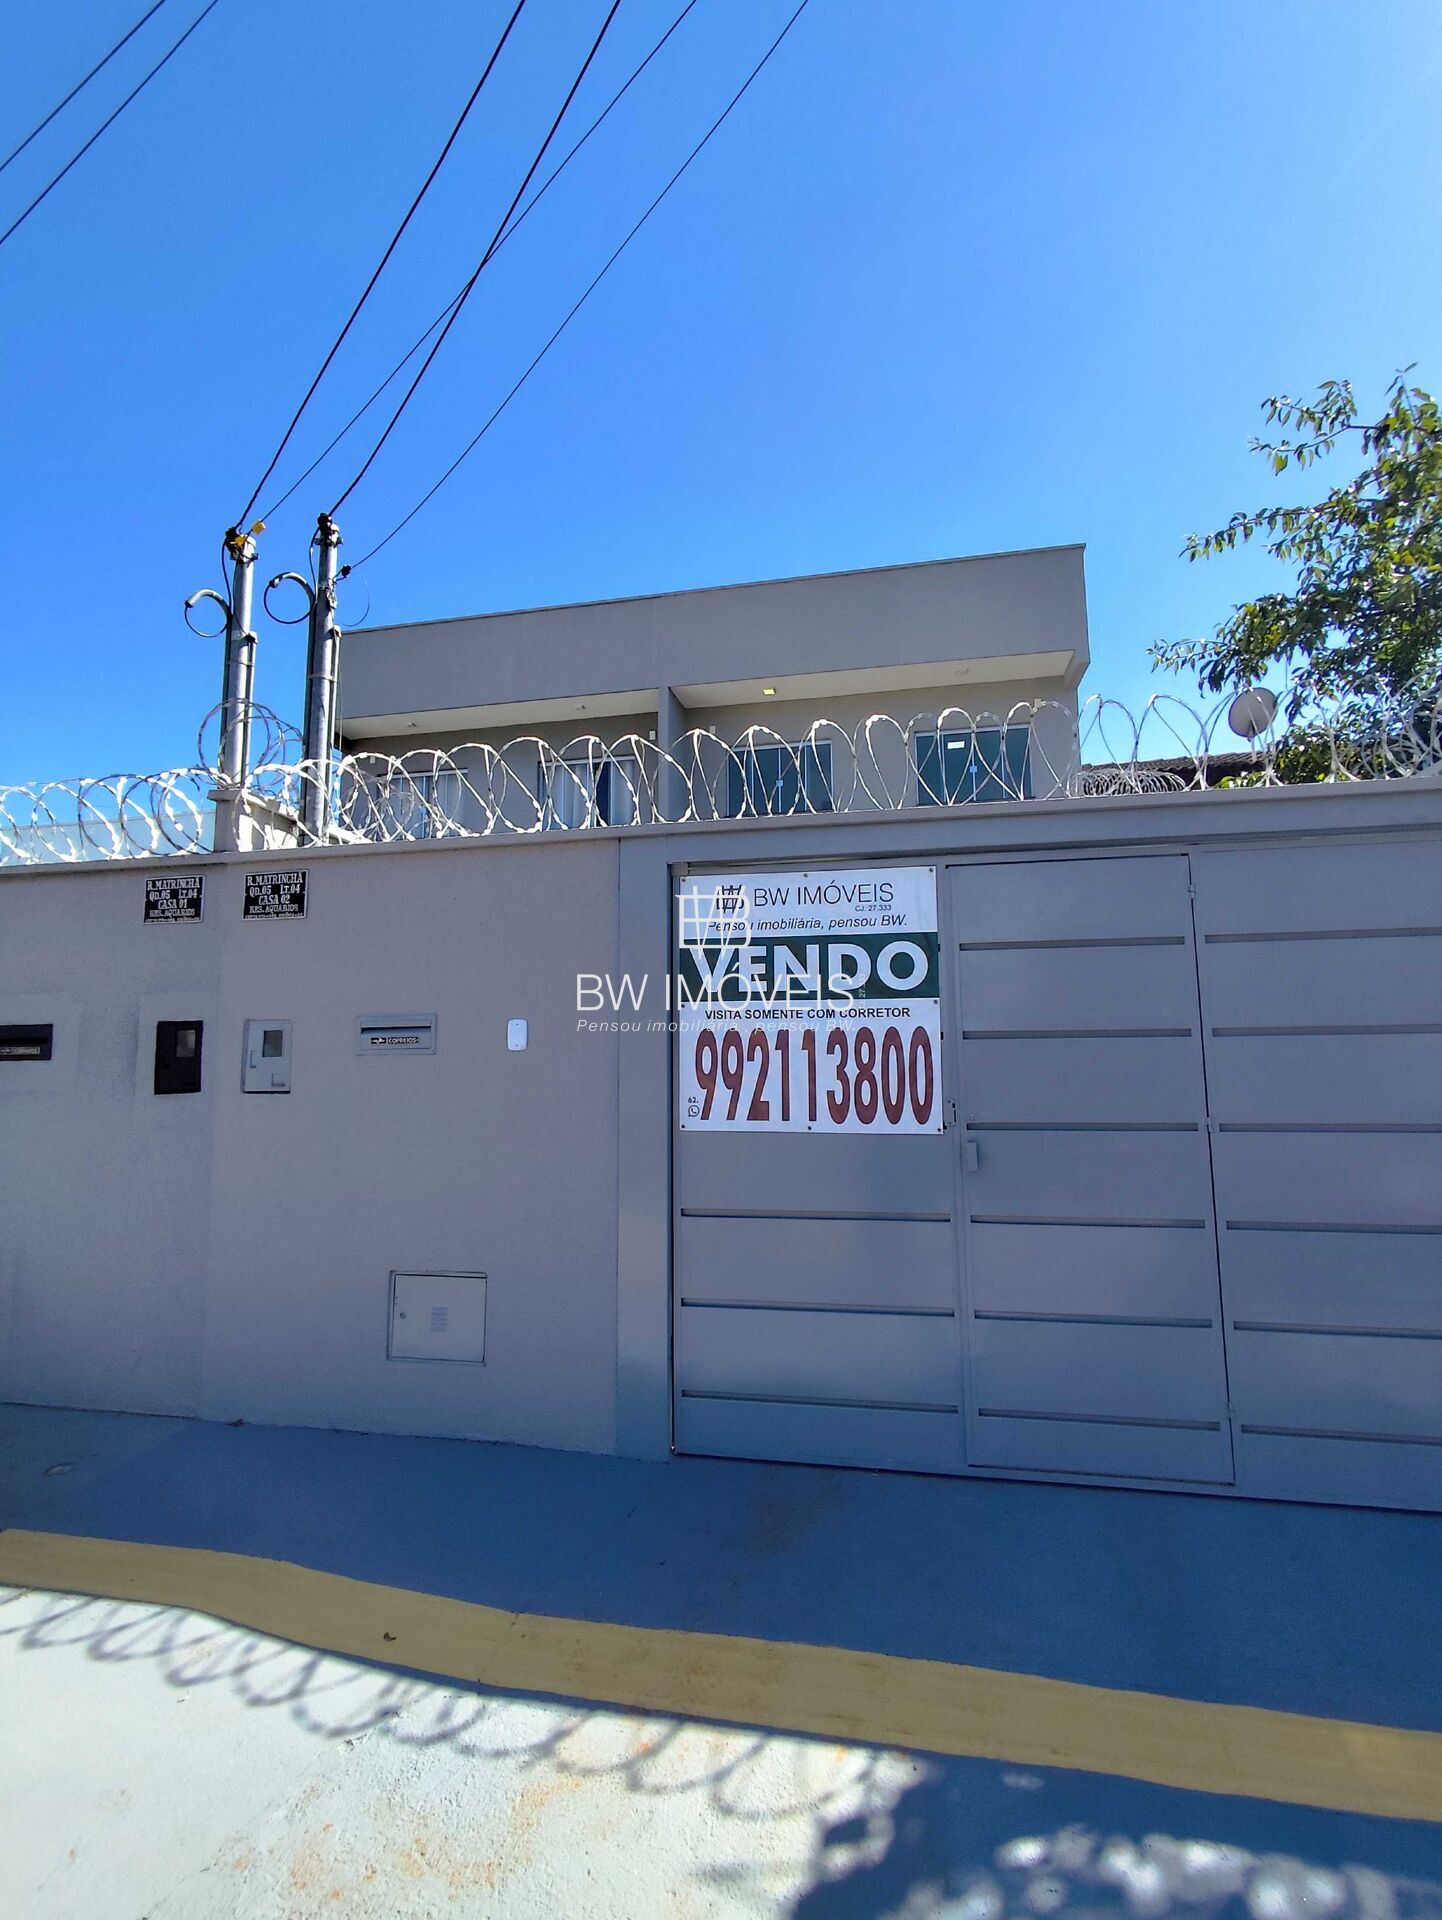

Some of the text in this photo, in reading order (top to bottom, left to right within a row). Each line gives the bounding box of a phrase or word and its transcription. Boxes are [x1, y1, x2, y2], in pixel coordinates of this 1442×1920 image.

[258, 894, 290, 906] CASA 02
[754, 888, 790, 907] BW
[797, 880, 894, 905] IMÓVEIS
[158, 898, 188, 910] CASA 01
[757, 917, 824, 931] imobiliária,
[828, 917, 877, 930] pensou
[881, 914, 908, 926] BW.
[688, 940, 930, 993] VENDO
[705, 1007, 911, 1020] VISITA SOMENTE COM CORRETOR
[694, 1025, 935, 1125] 992113800
